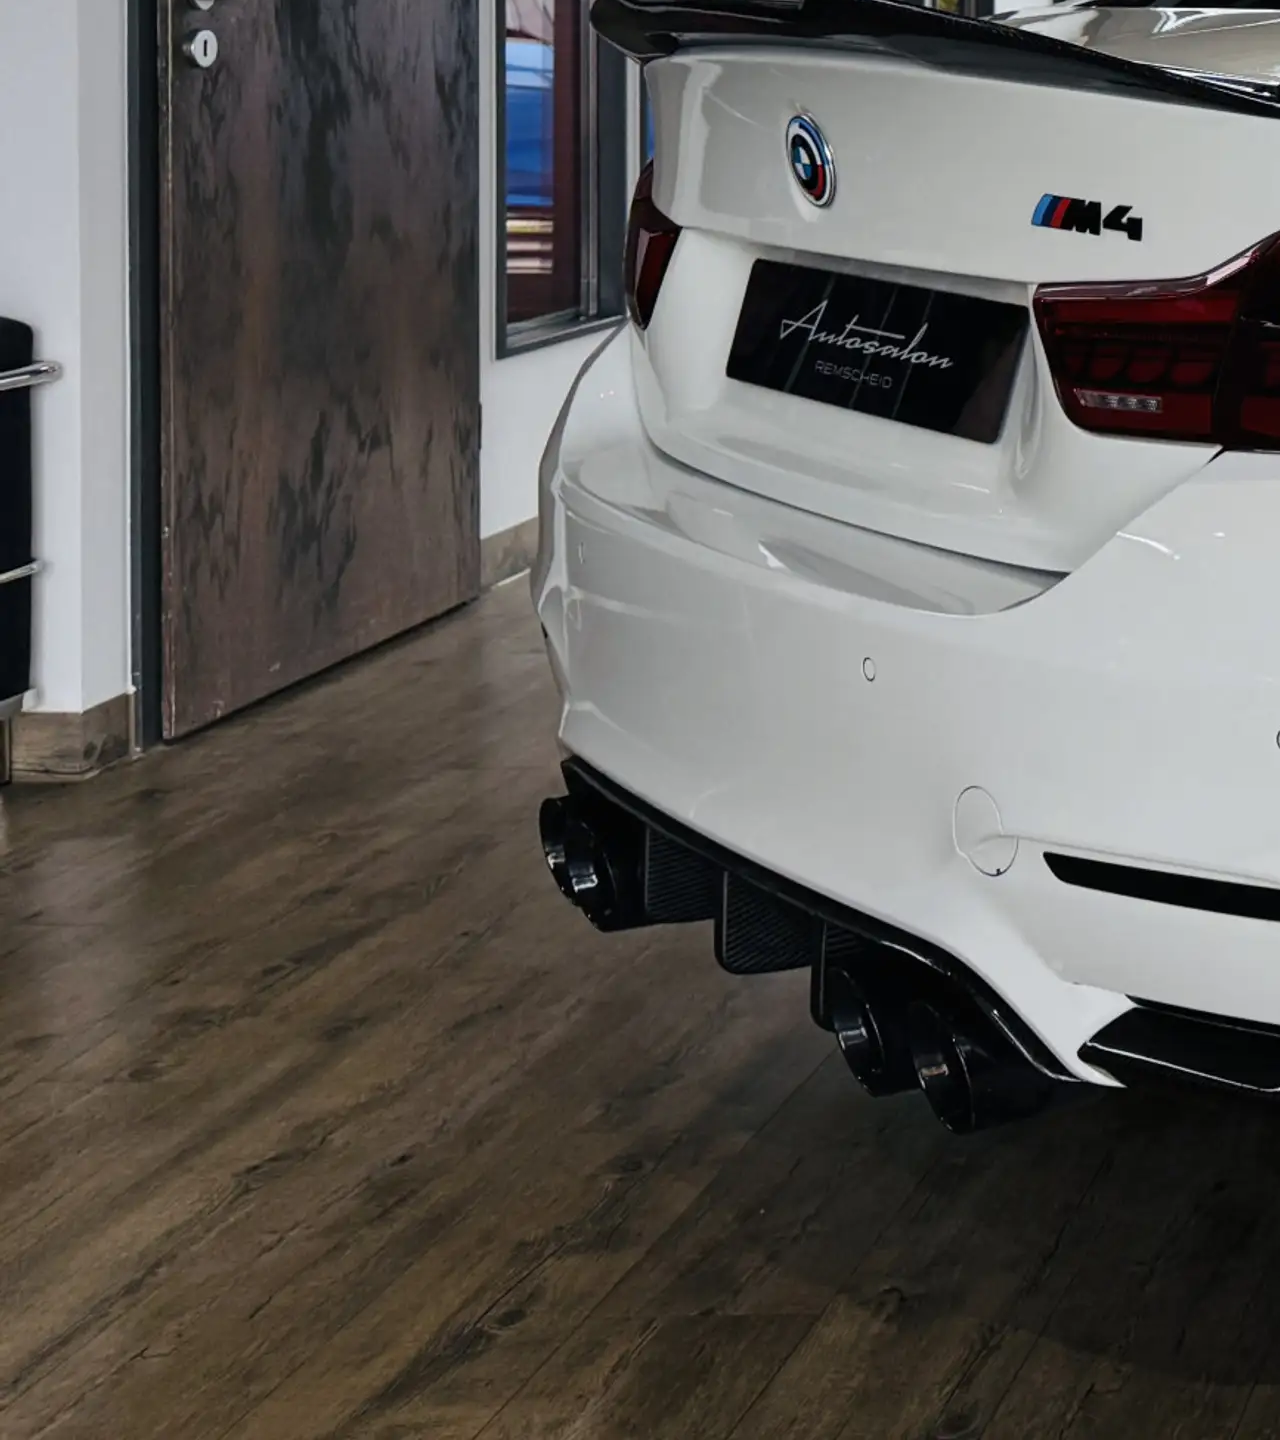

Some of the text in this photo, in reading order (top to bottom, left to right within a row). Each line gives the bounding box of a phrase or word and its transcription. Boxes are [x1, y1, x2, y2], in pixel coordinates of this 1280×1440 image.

[1050, 194, 1143, 242] M4
[779, 298, 954, 369] Autosalon
[814, 360, 892, 389] REMSCHEID
